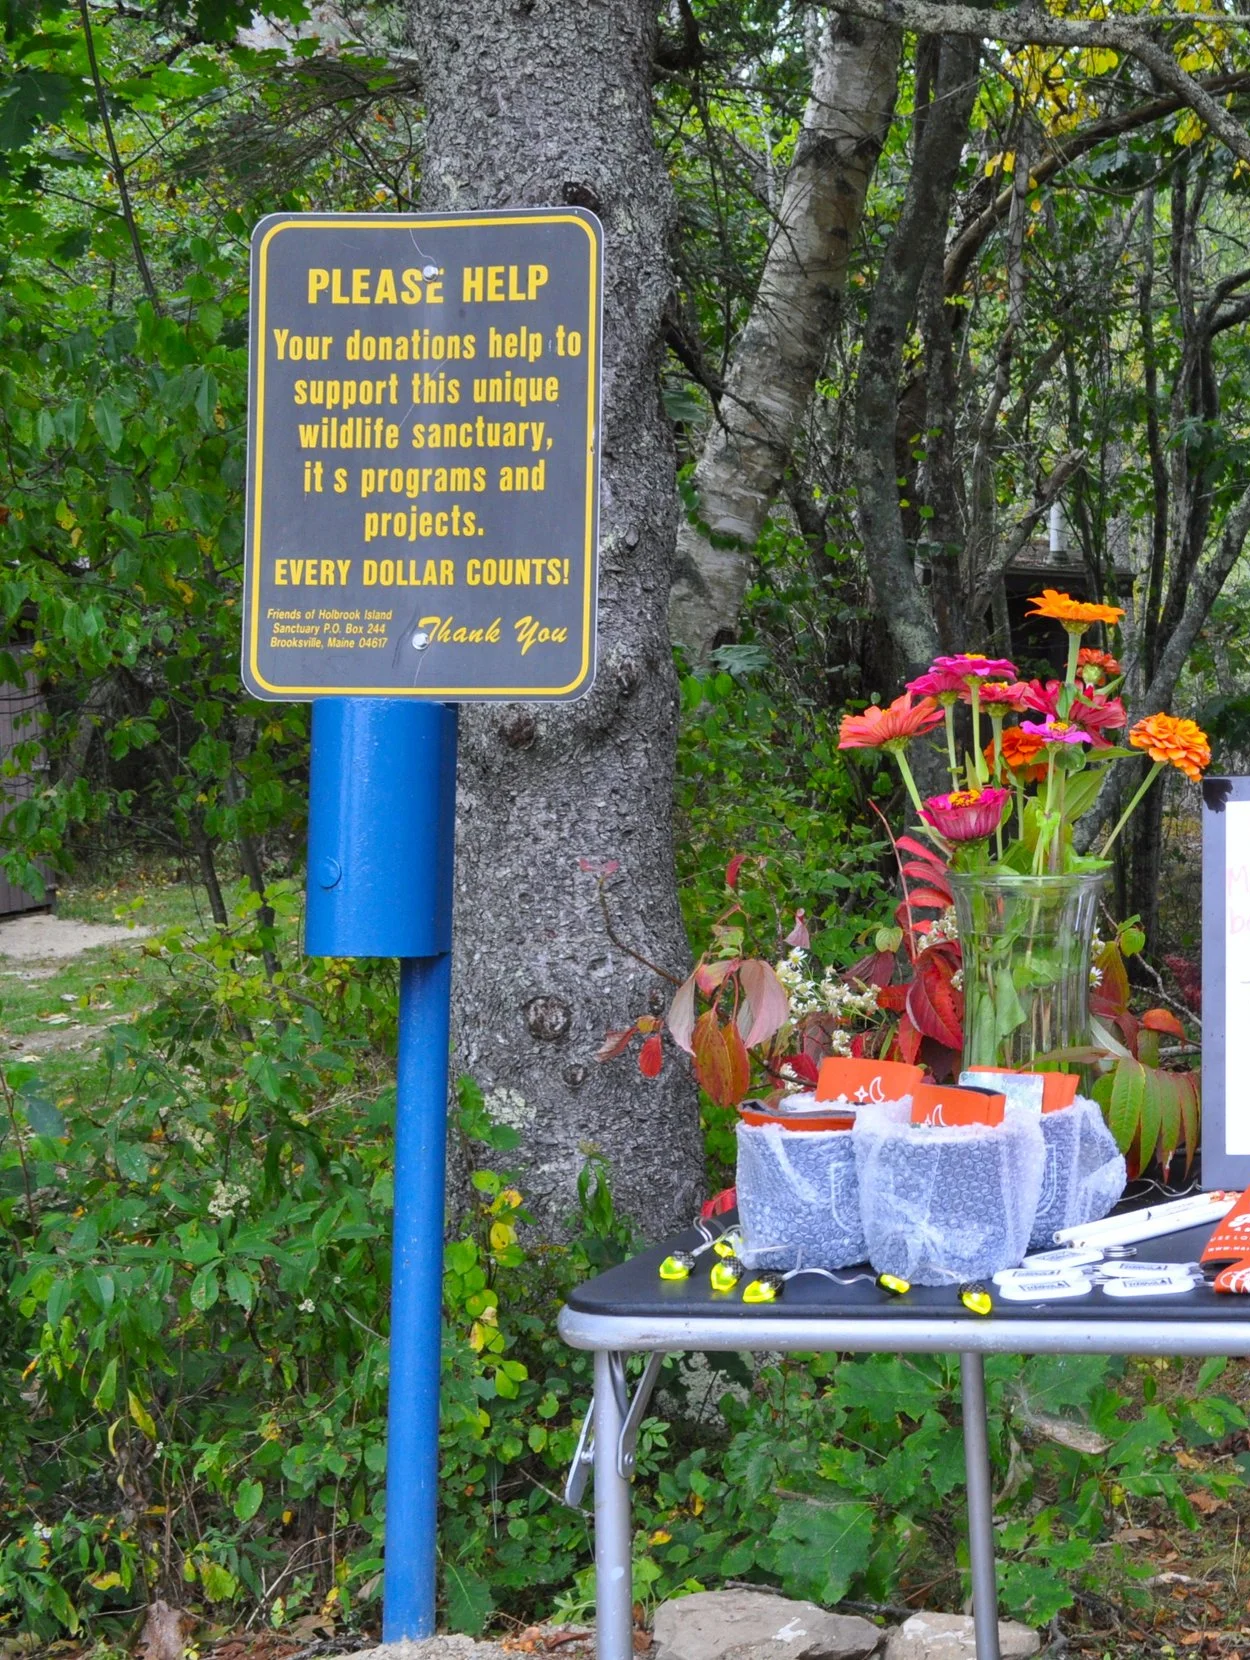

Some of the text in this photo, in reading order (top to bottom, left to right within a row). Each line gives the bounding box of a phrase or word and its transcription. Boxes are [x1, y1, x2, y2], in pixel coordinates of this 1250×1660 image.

[307, 264, 549, 305] PLEASE HELP
[273, 325, 582, 362] Your donations help to
[294, 370, 559, 410] support this unique
[299, 415, 553, 451] wildlife sanctuary,
[361, 466, 486, 498] programs
[499, 459, 545, 491] and
[364, 505, 484, 542] projects.
[274, 558, 570, 586] EVERY DOLLAR COUNTS!
[267, 608, 393, 620] Friends of Holbrook Island
[273, 622, 386, 636] Sanctuary P.O. Box 244
[270, 636, 388, 649] Brooksville, Maine 04617
[418, 615, 568, 656] Thank You
